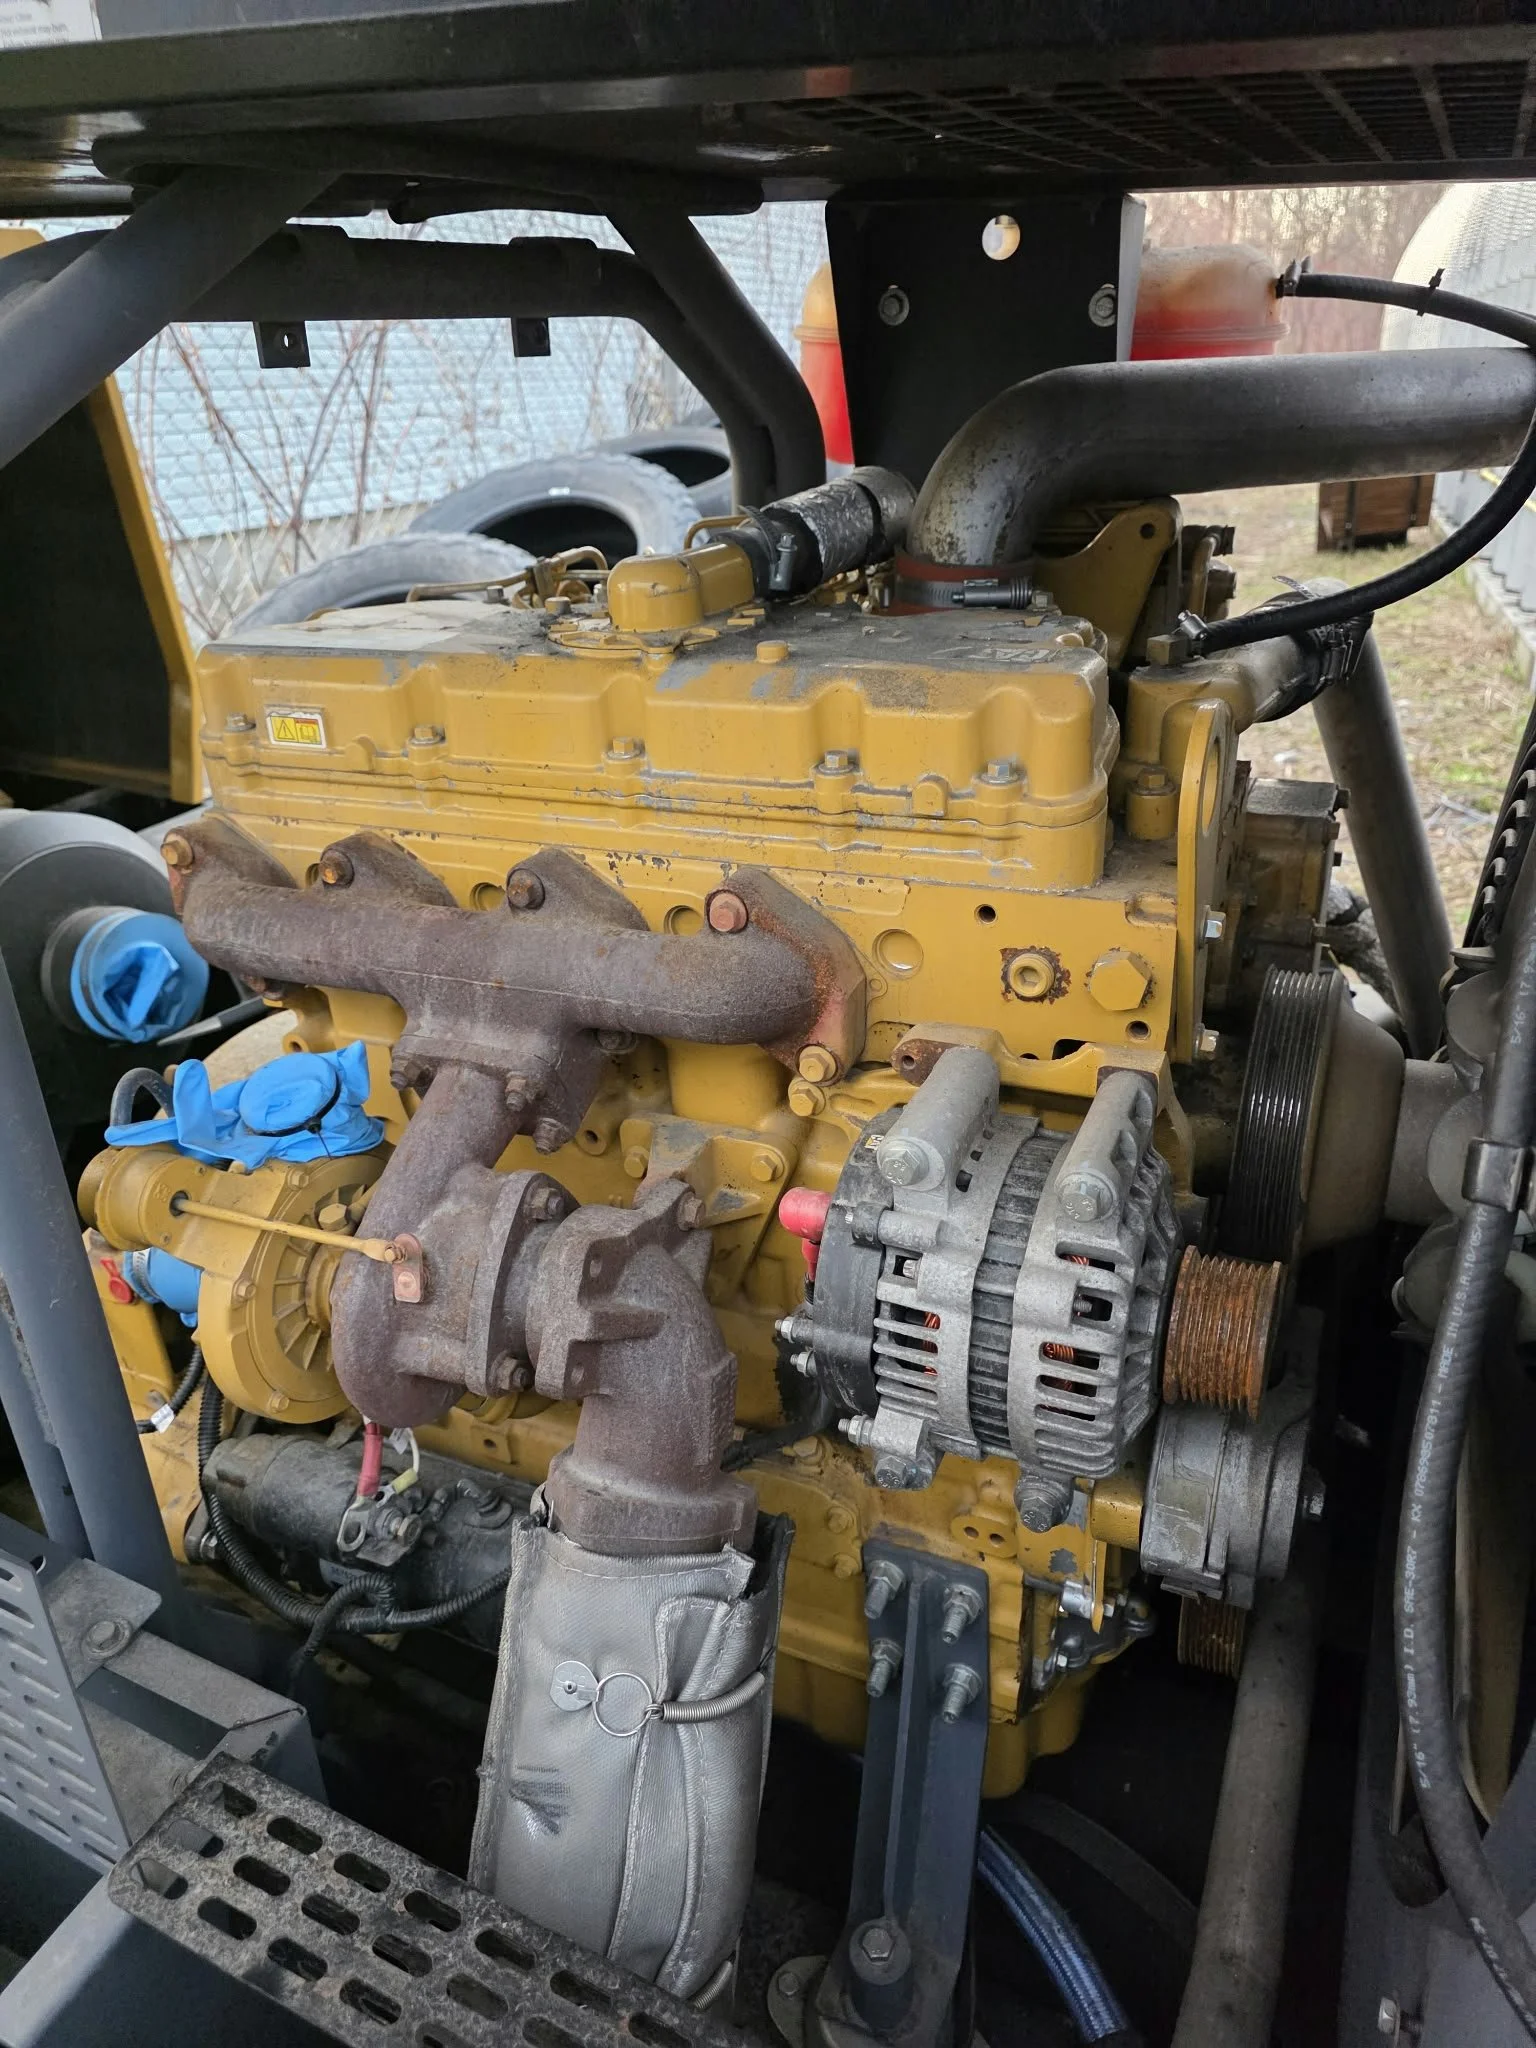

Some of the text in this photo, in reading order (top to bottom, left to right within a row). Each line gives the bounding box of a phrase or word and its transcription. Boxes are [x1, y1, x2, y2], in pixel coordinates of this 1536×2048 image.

[864, 1134, 885, 1151] CAT
[1437, 1344, 1454, 1378] MADE
[1447, 1322, 1460, 1338] IN
